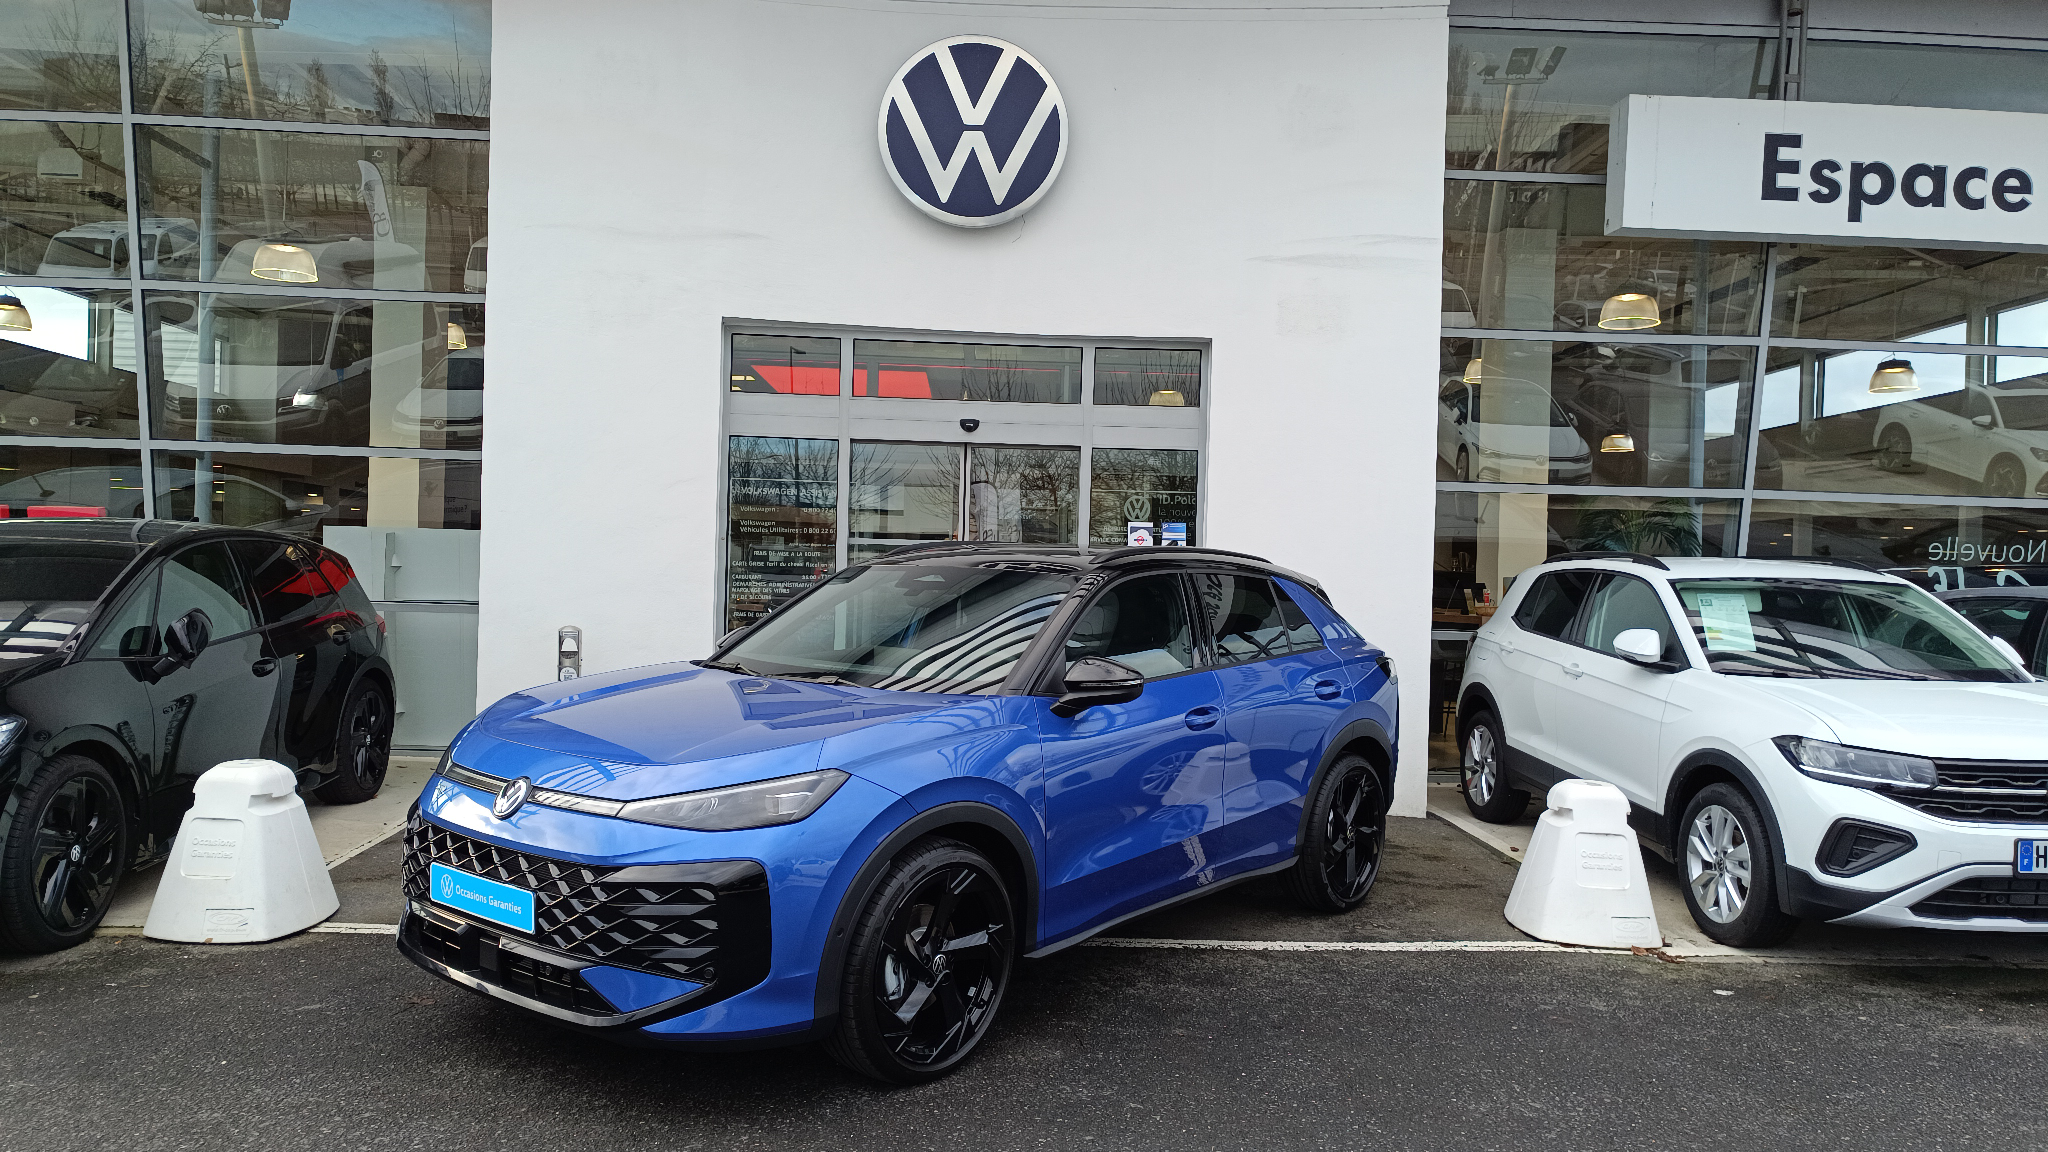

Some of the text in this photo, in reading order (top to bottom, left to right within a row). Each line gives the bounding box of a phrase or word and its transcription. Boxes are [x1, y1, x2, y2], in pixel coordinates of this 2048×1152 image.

[1761, 132, 2033, 223] Espace
[741, 487, 797, 495] VOLKSWAGEN
[192, 837, 237, 848] Occasions
[191, 849, 234, 859] Garanties
[1581, 850, 1624, 861] Occasions
[1582, 861, 1623, 872] Garanties
[456, 884, 522, 914] Occasions Garanties
